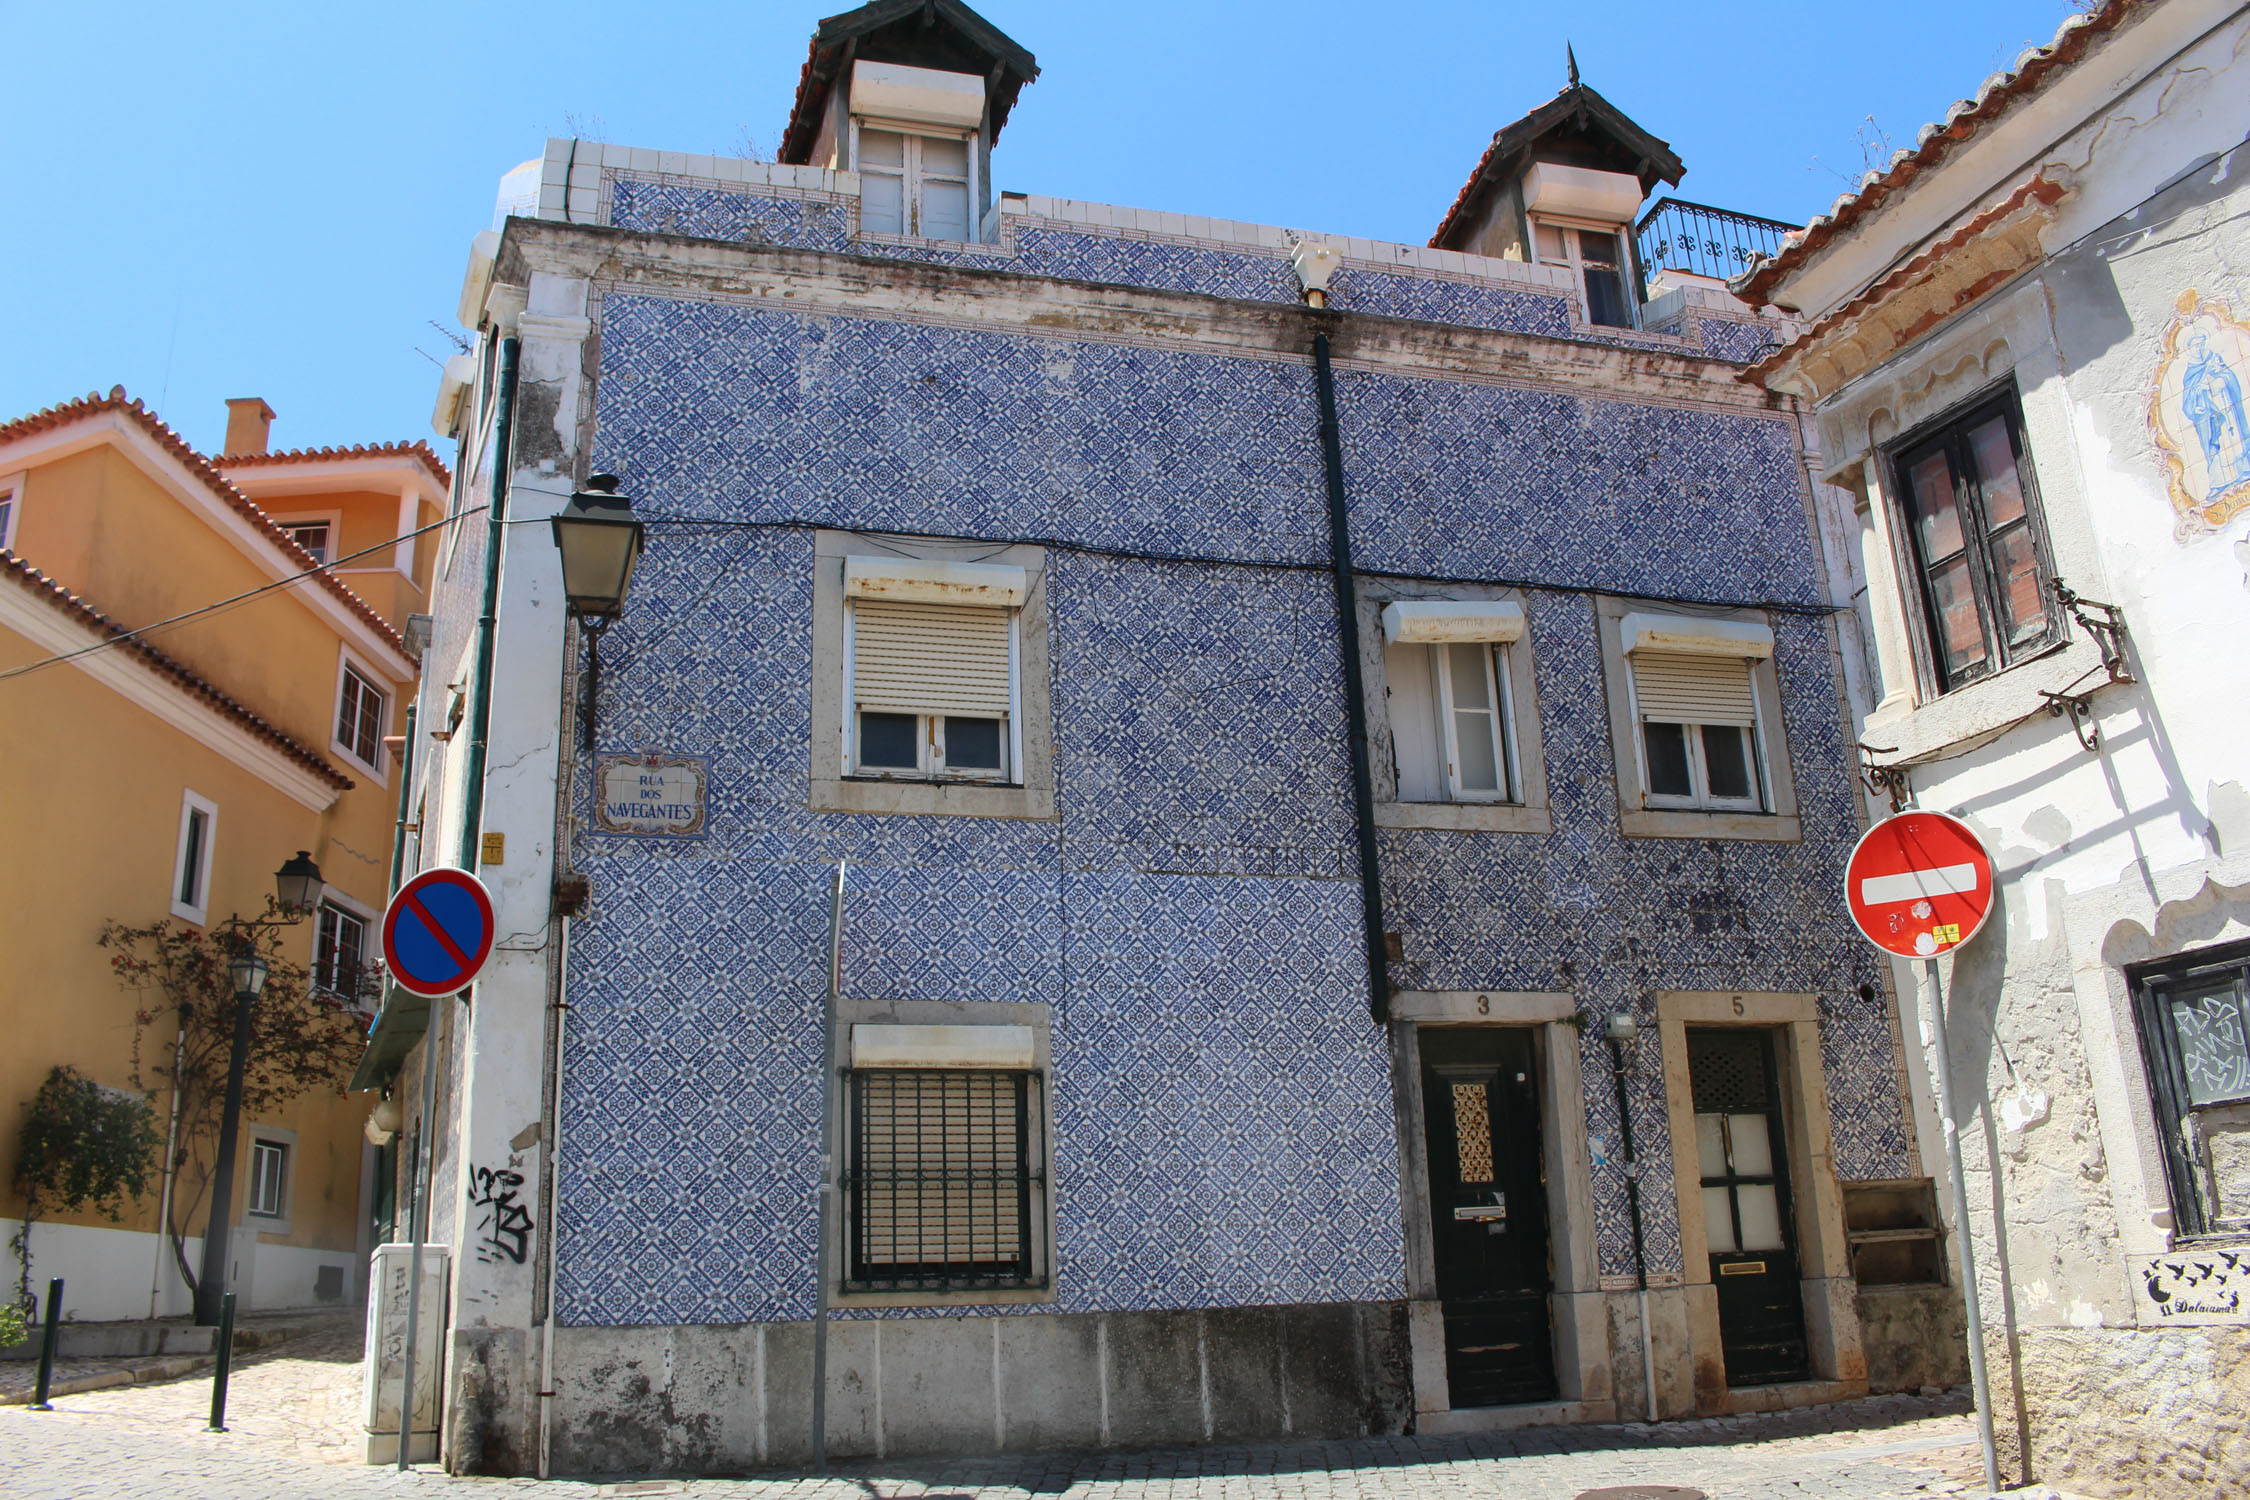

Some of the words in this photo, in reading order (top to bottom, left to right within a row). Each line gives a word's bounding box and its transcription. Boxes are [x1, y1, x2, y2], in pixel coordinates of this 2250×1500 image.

[639, 775, 664, 785] RUA
[640, 790, 662, 799] DOS
[607, 803, 691, 819] NAVEGANTES
[1477, 994, 1490, 1016] 3
[1732, 995, 1745, 1016] 5
